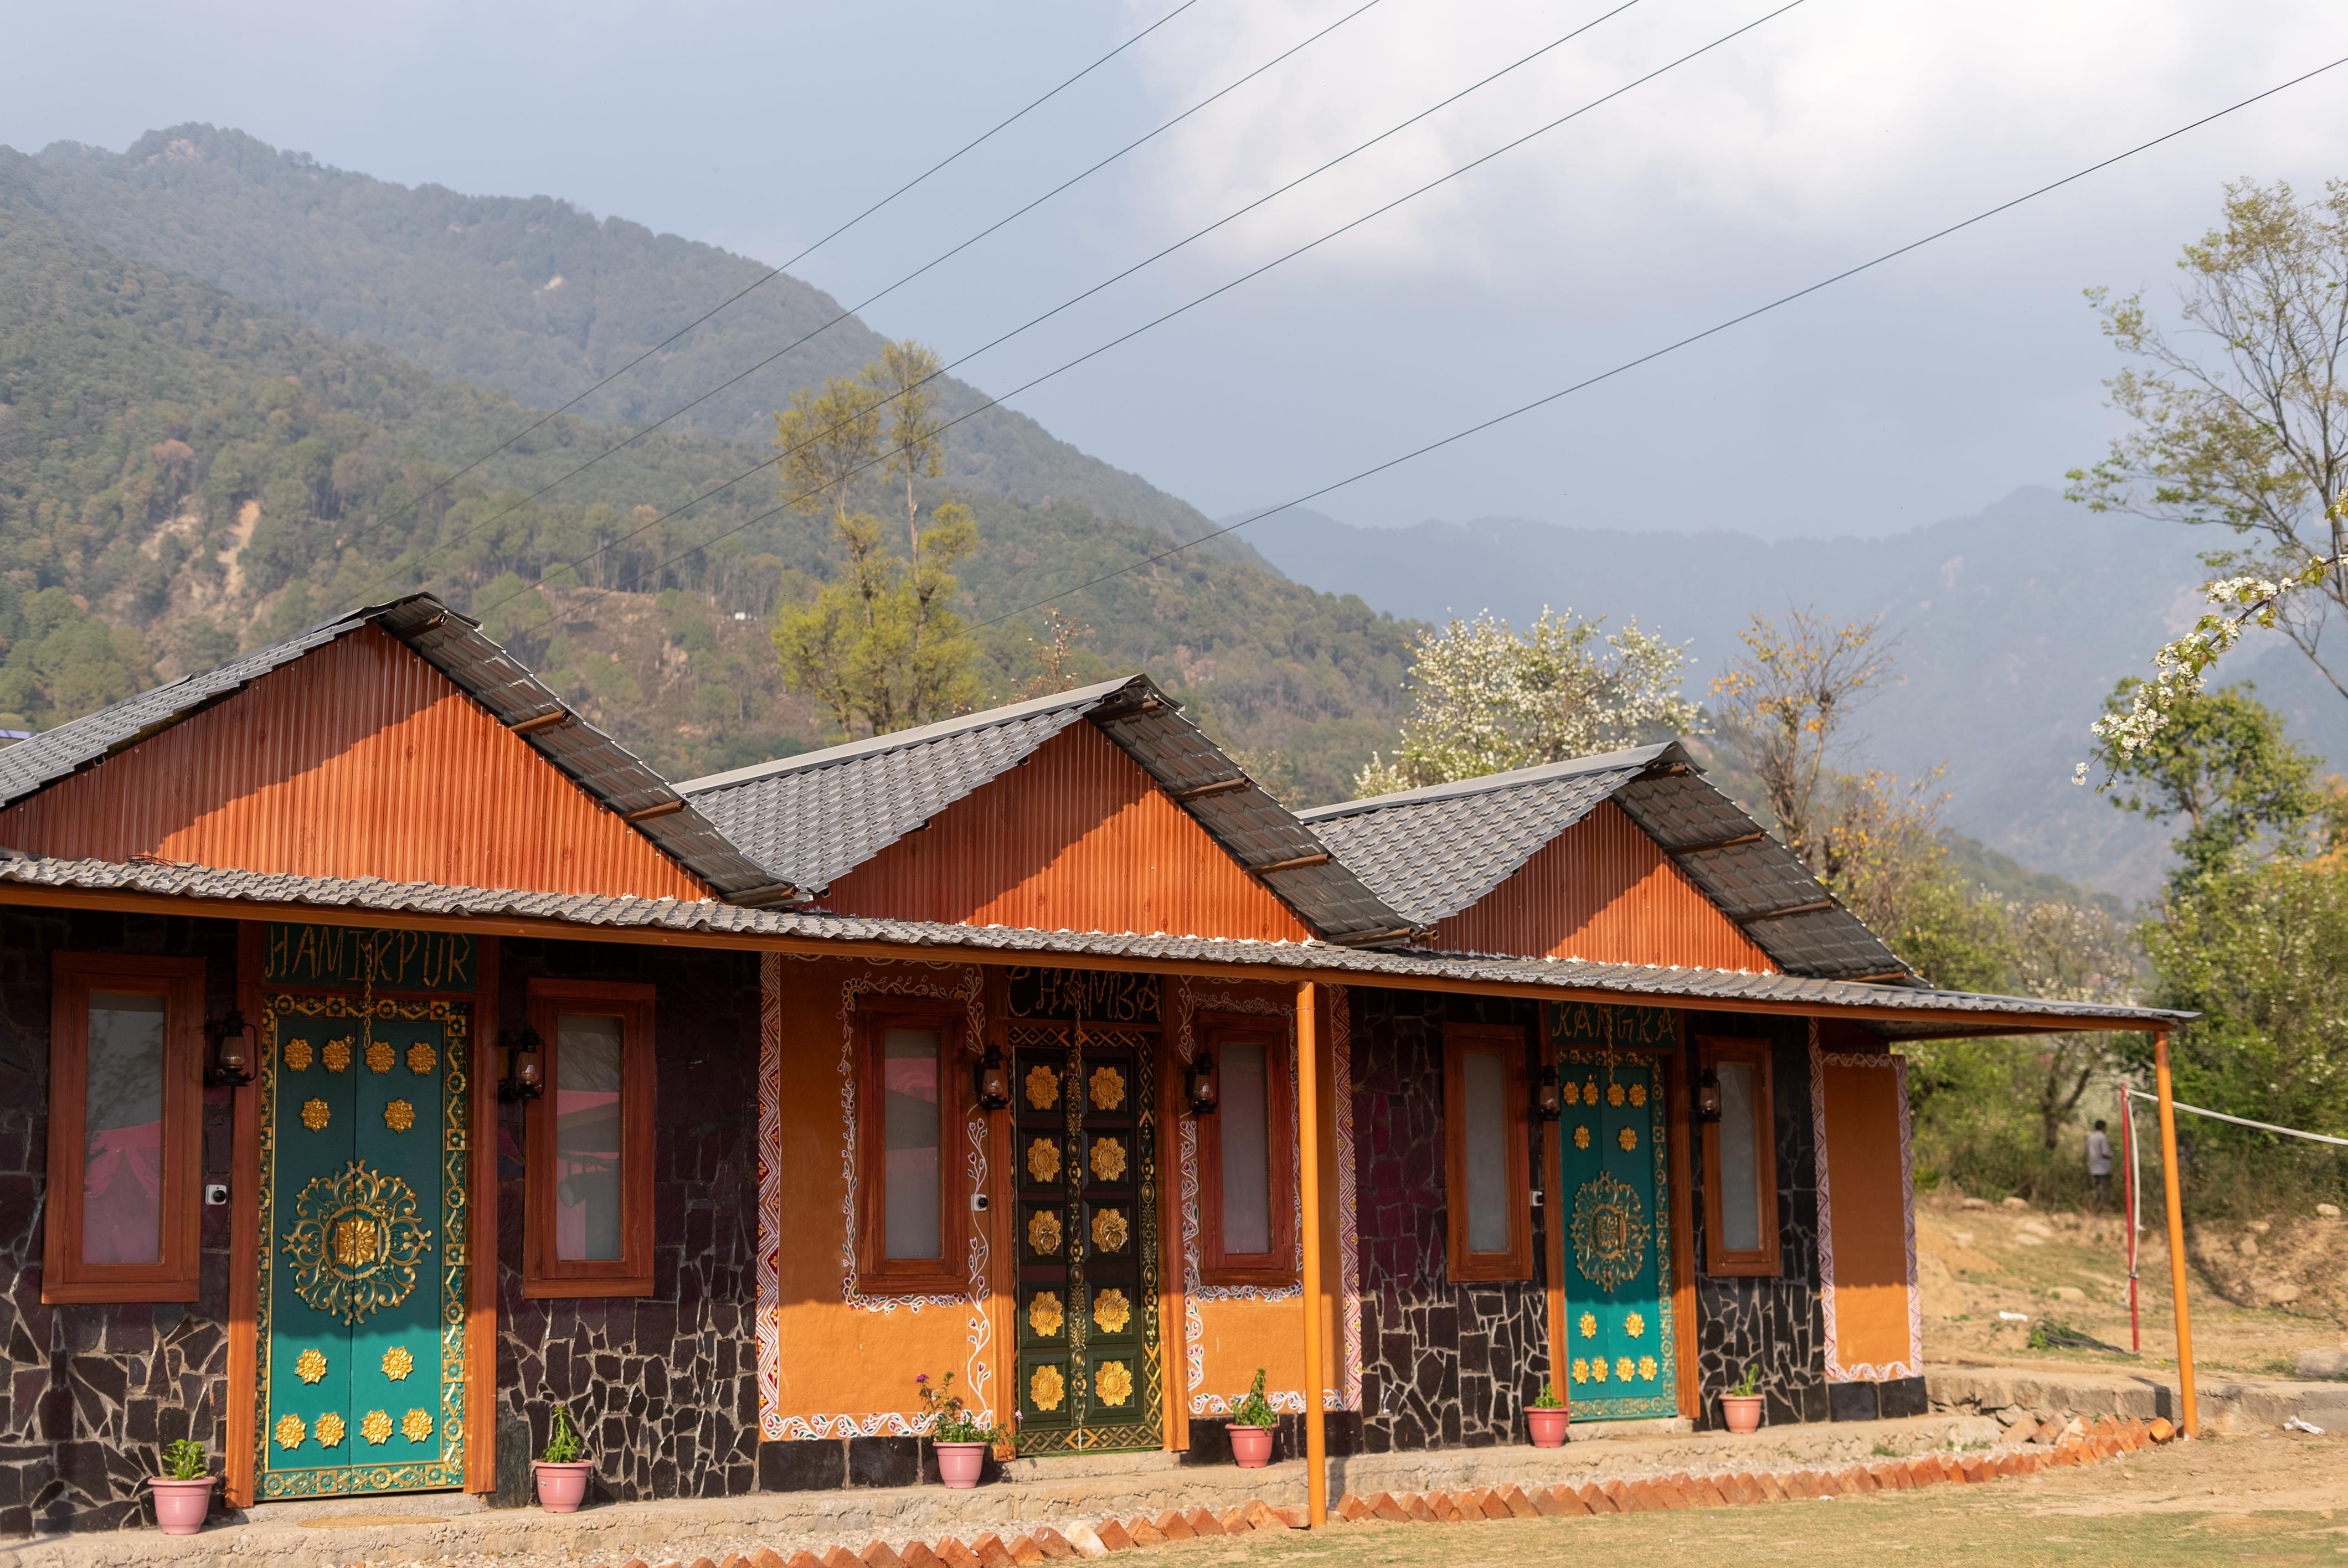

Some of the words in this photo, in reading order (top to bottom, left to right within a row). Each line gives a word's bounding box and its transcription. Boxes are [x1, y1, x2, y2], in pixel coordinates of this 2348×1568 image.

[264, 925, 471, 988] HAMIRPUR
[1006, 966, 1162, 1022] CHAMBA
[1551, 1000, 1676, 1043] KANGRA
